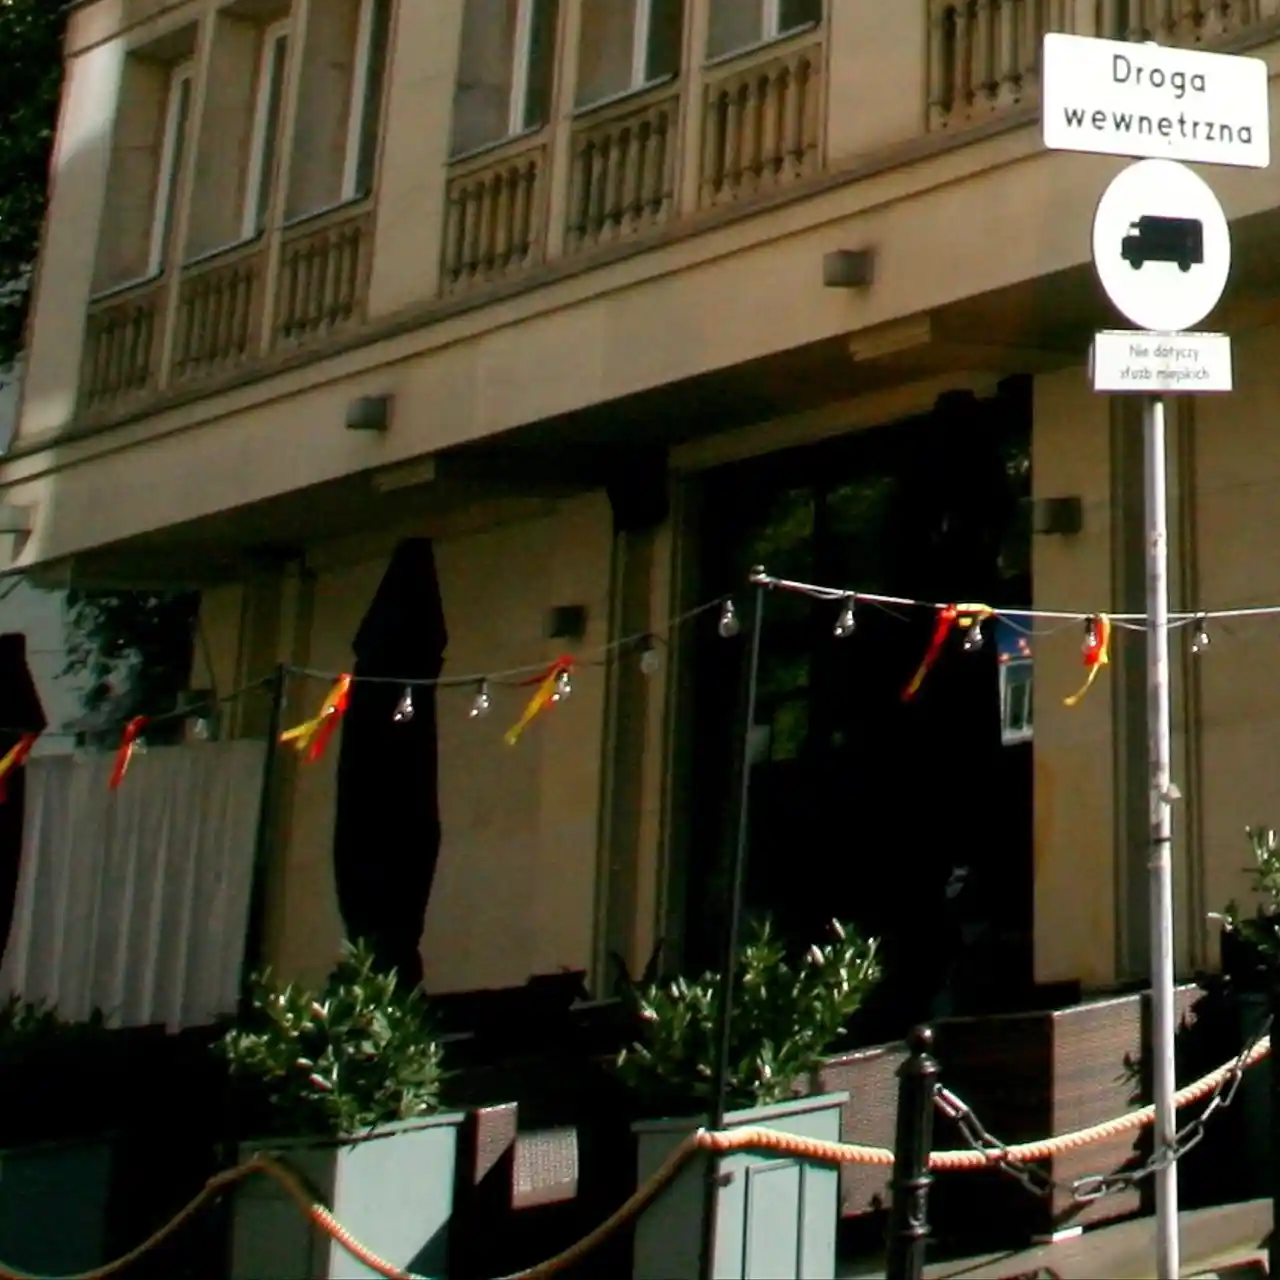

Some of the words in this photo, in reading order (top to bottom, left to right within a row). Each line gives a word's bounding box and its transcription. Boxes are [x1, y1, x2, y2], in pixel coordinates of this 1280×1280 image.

[1113, 53, 1206, 99] Droga
[1064, 106, 1253, 145] wewnętrzna
[1129, 344, 1149, 358] Nie
[1153, 344, 1200, 363] dotyczy
